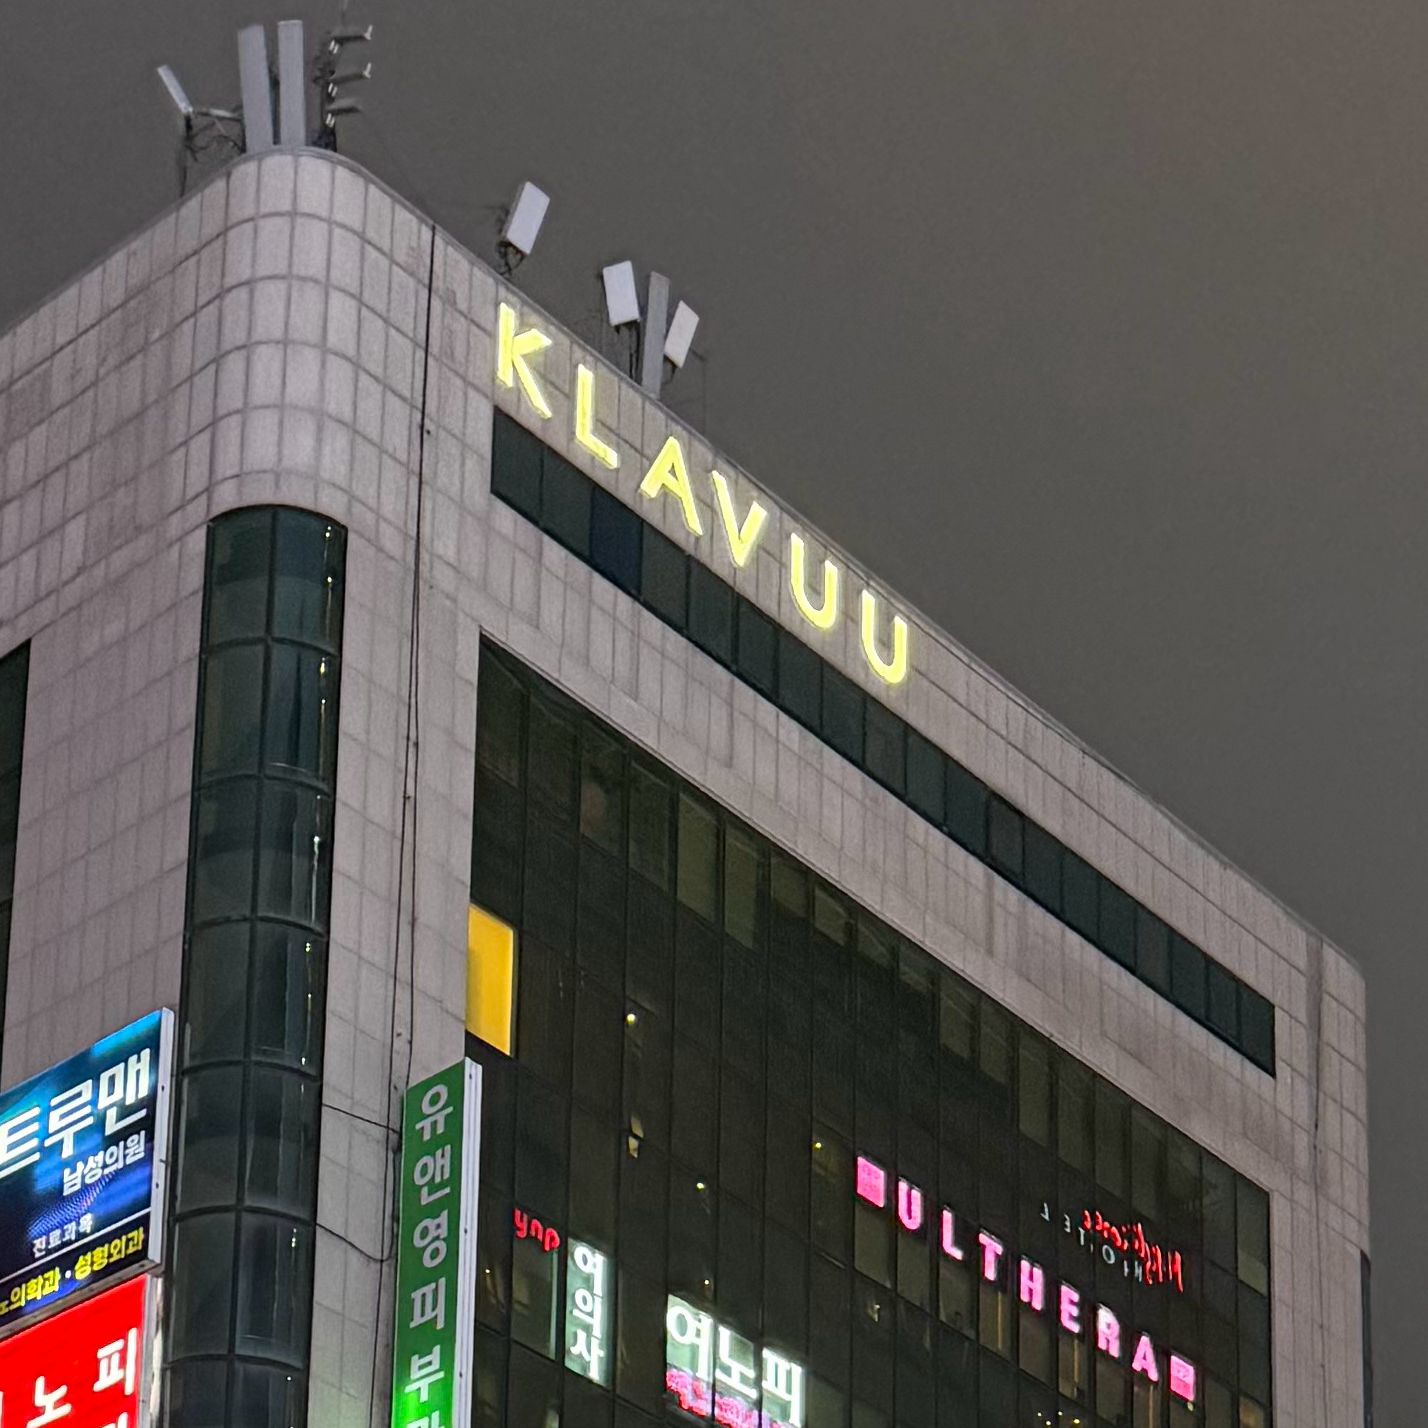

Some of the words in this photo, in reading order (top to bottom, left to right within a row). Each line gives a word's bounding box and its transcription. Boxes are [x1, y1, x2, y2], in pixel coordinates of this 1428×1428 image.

[497, 302, 908, 685] KLAVUU
[62, 1130, 145, 1196] 남성의원
[74, 1226, 144, 1280] 성형외과
[570, 1245, 606, 1380] 여의사
[897, 1178, 1159, 1383] ULTHERA
[666, 1304, 803, 1428] 여노피
